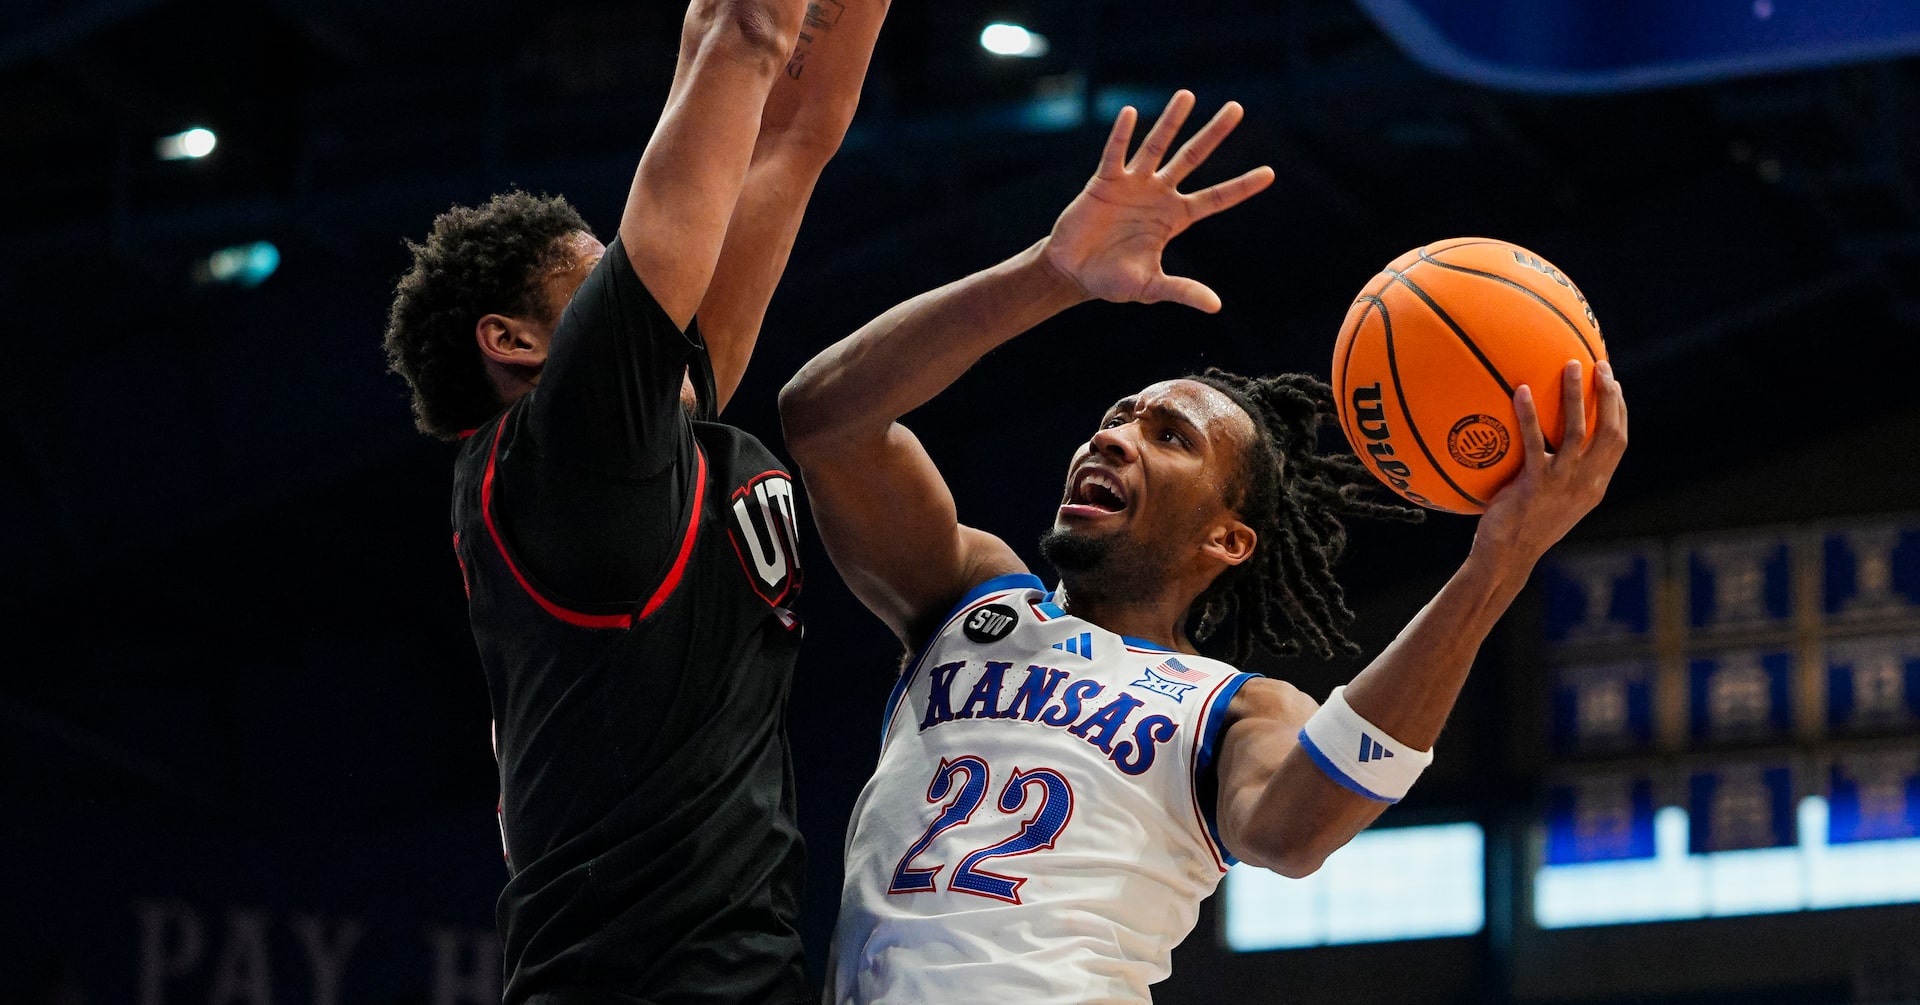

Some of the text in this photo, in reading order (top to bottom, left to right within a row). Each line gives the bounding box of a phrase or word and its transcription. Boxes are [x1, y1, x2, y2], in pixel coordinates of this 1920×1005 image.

[970, 609, 1013, 636] SW
[919, 661, 1179, 775] KANSAS
[887, 755, 1075, 906] 22
[135, 898, 367, 1005] PAY
